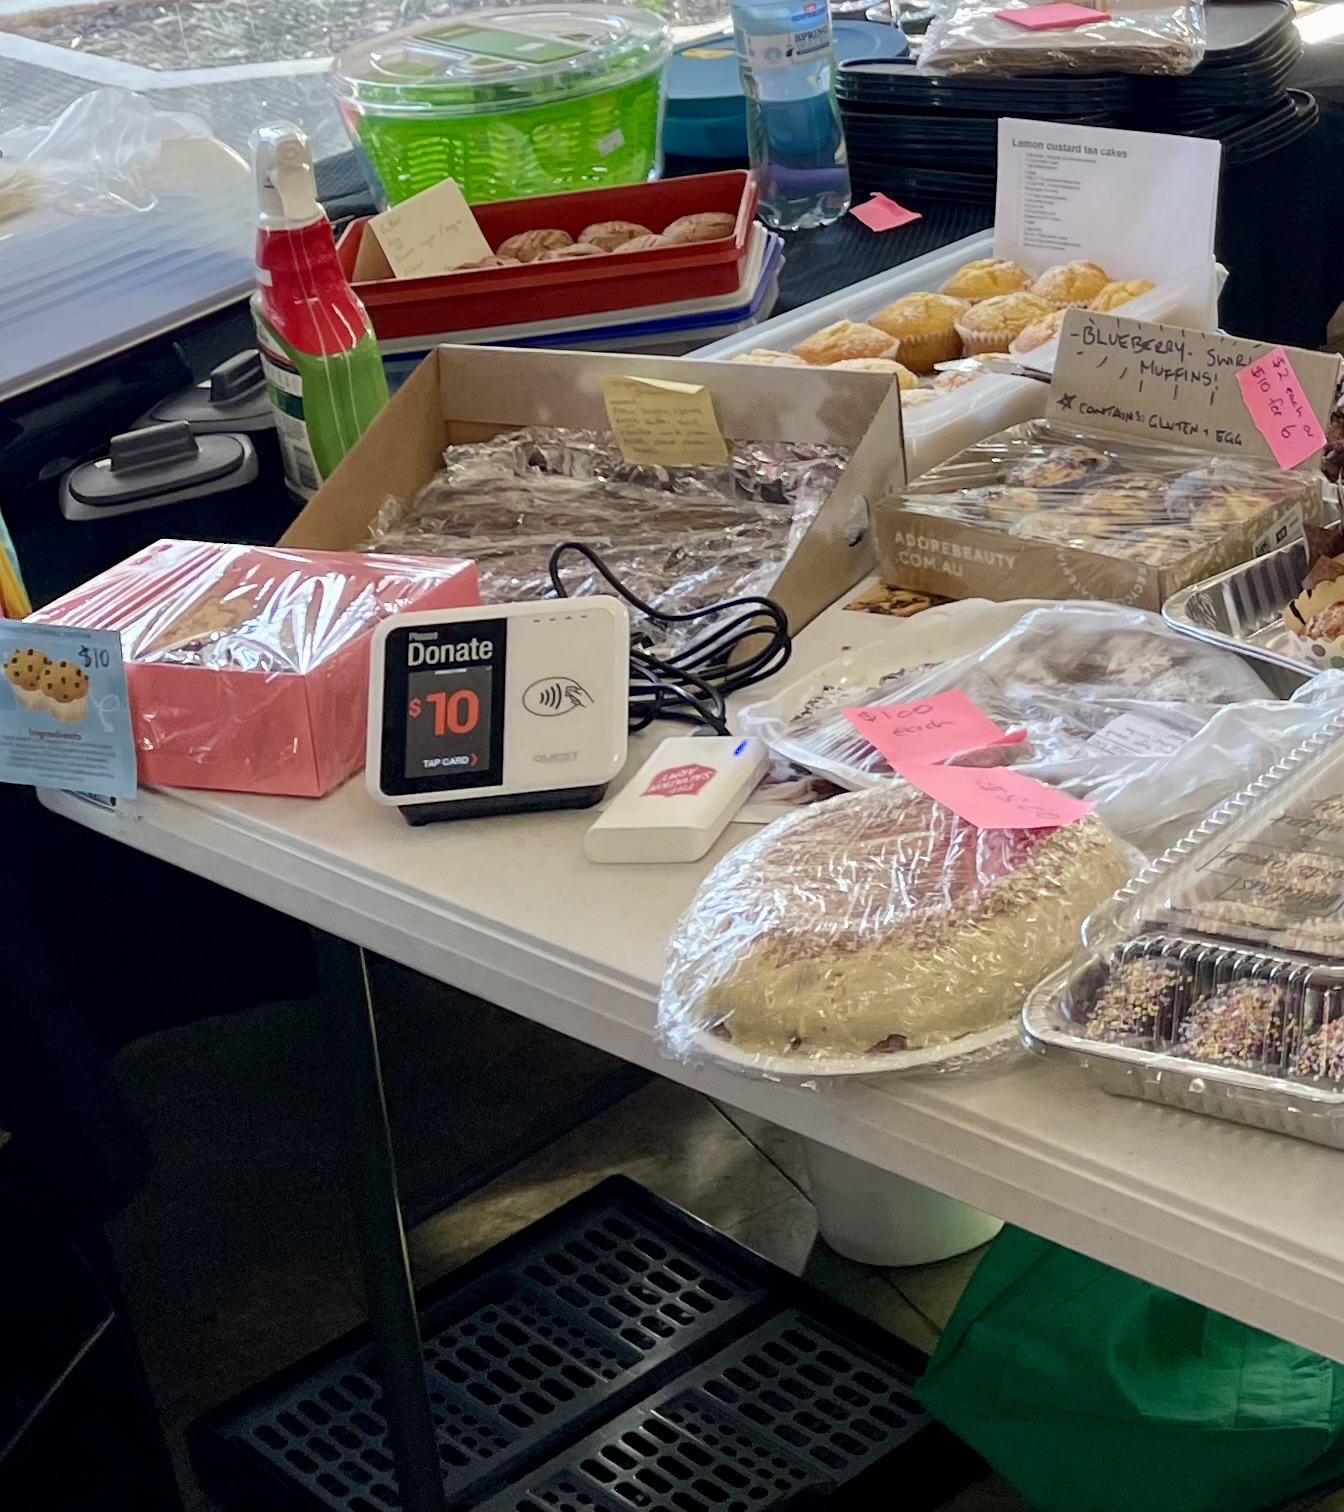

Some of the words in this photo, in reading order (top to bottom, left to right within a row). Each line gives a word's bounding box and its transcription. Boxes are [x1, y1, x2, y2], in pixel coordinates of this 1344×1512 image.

[1012, 138, 1044, 150] Lemon
[1046, 142, 1081, 154] custard
[1083, 145, 1098, 155] tea
[1100, 148, 1127, 159] cakes
[1207, 349, 1252, 368] SWIR
[1272, 356, 1289, 381] $2
[1140, 360, 1219, 390] MUFFINS!
[1251, 365, 1271, 393] $10
[1149, 414, 1199, 436] GLUTEN
[1215, 430, 1242, 446] EGG
[894, 531, 1015, 569] ADOREBEAUTY
[78, 644, 111, 669] $10
[408, 637, 494, 667] Donate
[422, 758, 443, 769] TAP
[445, 755, 470, 768] CARD
